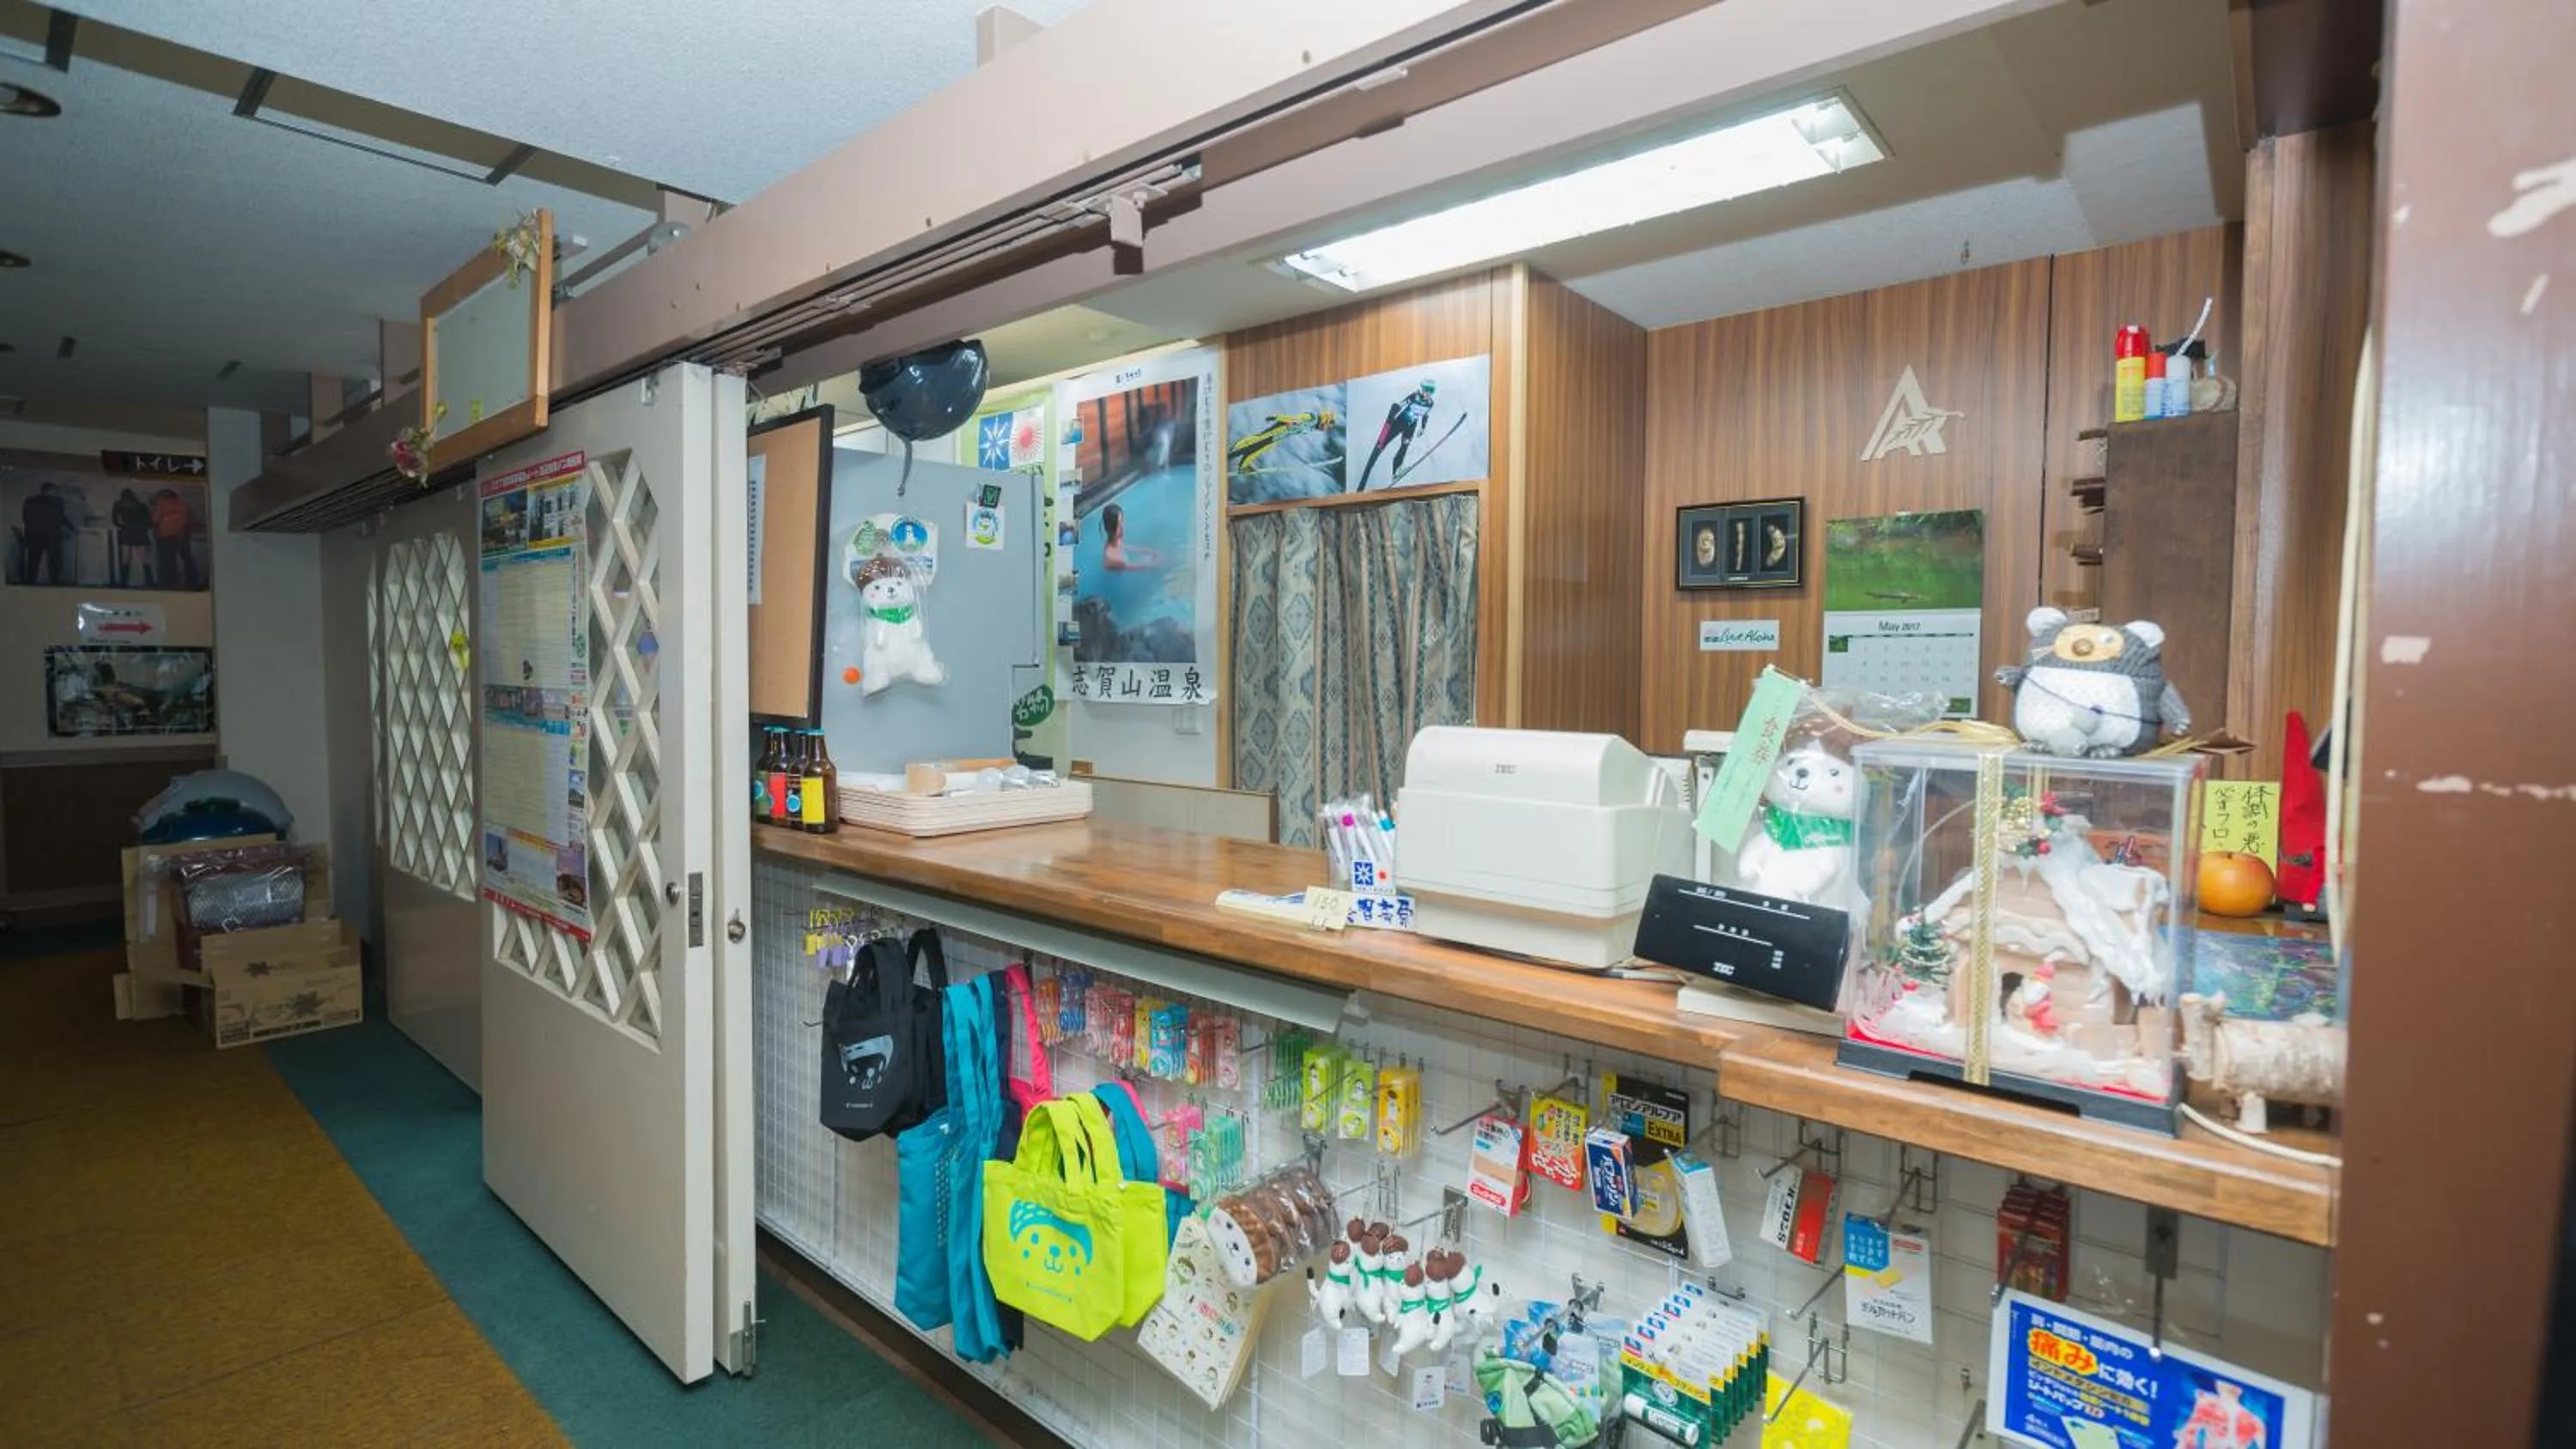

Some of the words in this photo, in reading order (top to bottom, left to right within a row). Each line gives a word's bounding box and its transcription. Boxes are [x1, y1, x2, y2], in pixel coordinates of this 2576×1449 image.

[136, 456, 179, 472] トイレ
[1878, 620, 1899, 633] May
[1901, 621, 1922, 631] 2017
[1072, 665, 1204, 700] 志賀山温泉
[1648, 1121, 1683, 1146] EXTRA
